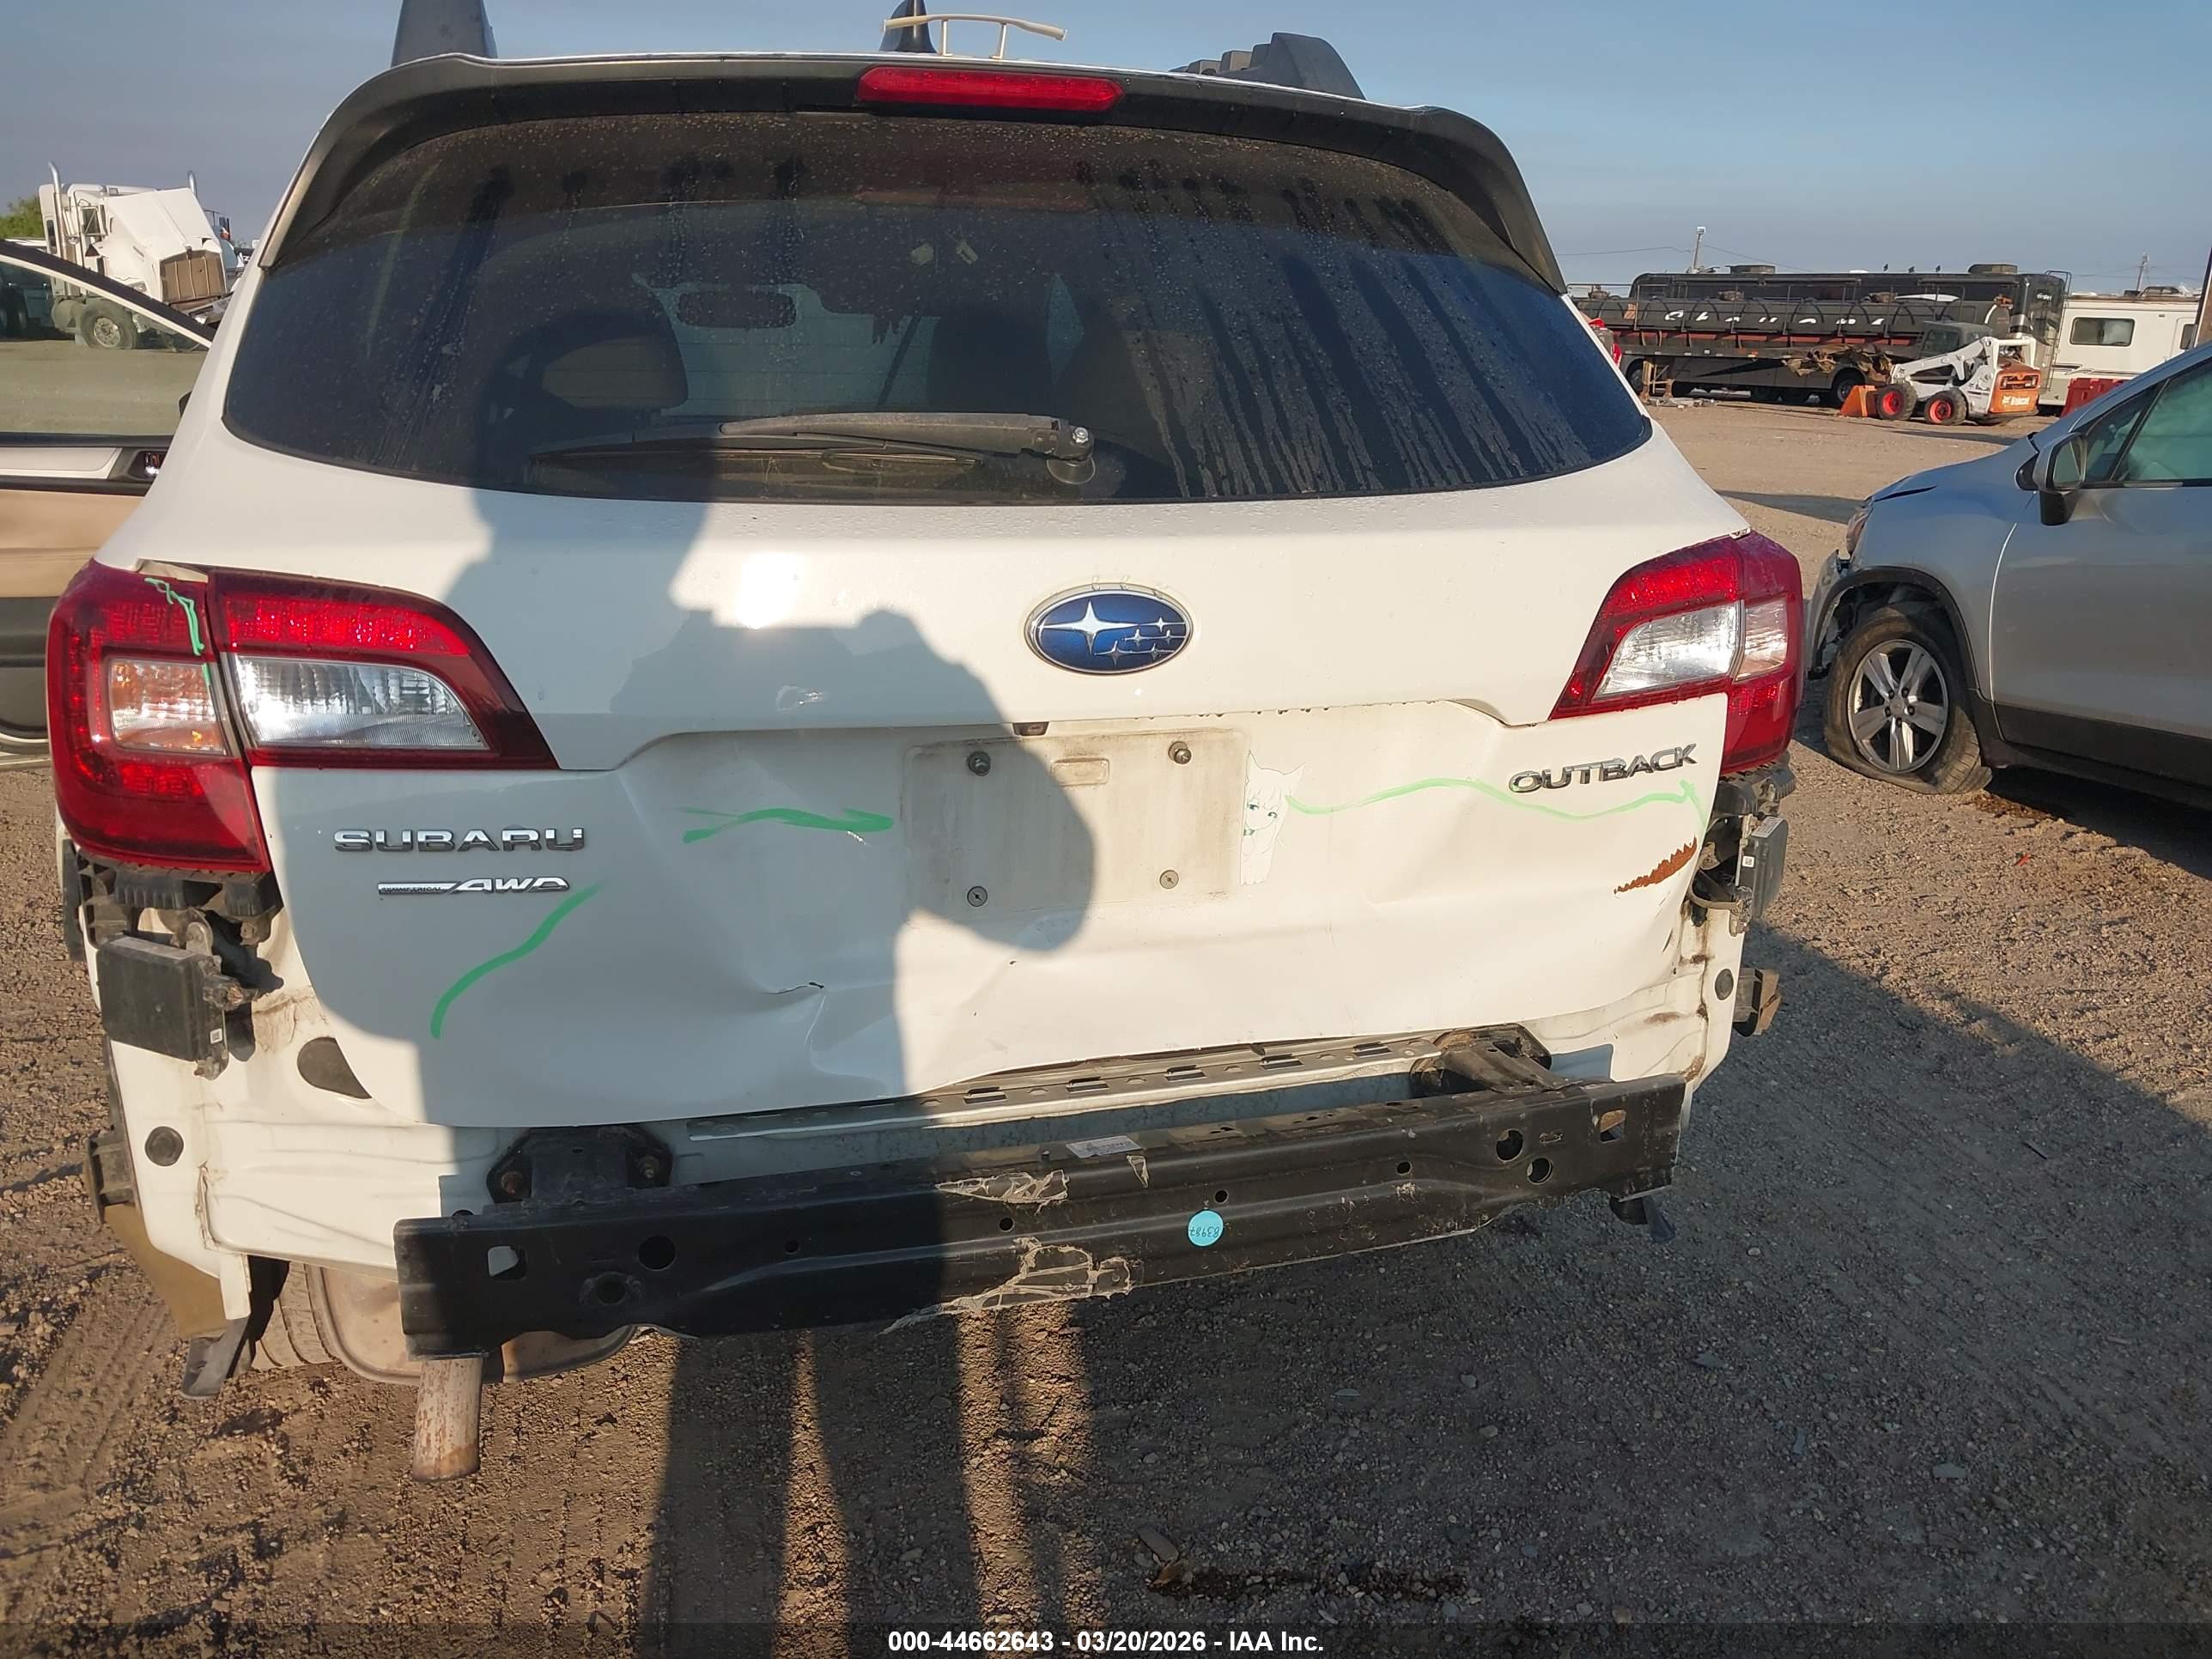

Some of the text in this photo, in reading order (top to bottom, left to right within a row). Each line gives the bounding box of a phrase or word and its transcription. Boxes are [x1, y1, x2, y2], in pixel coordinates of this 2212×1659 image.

[1508, 743, 1698, 793] OUTBACK
[333, 827, 585, 853] SUBARU
[449, 876, 570, 895] AWD
